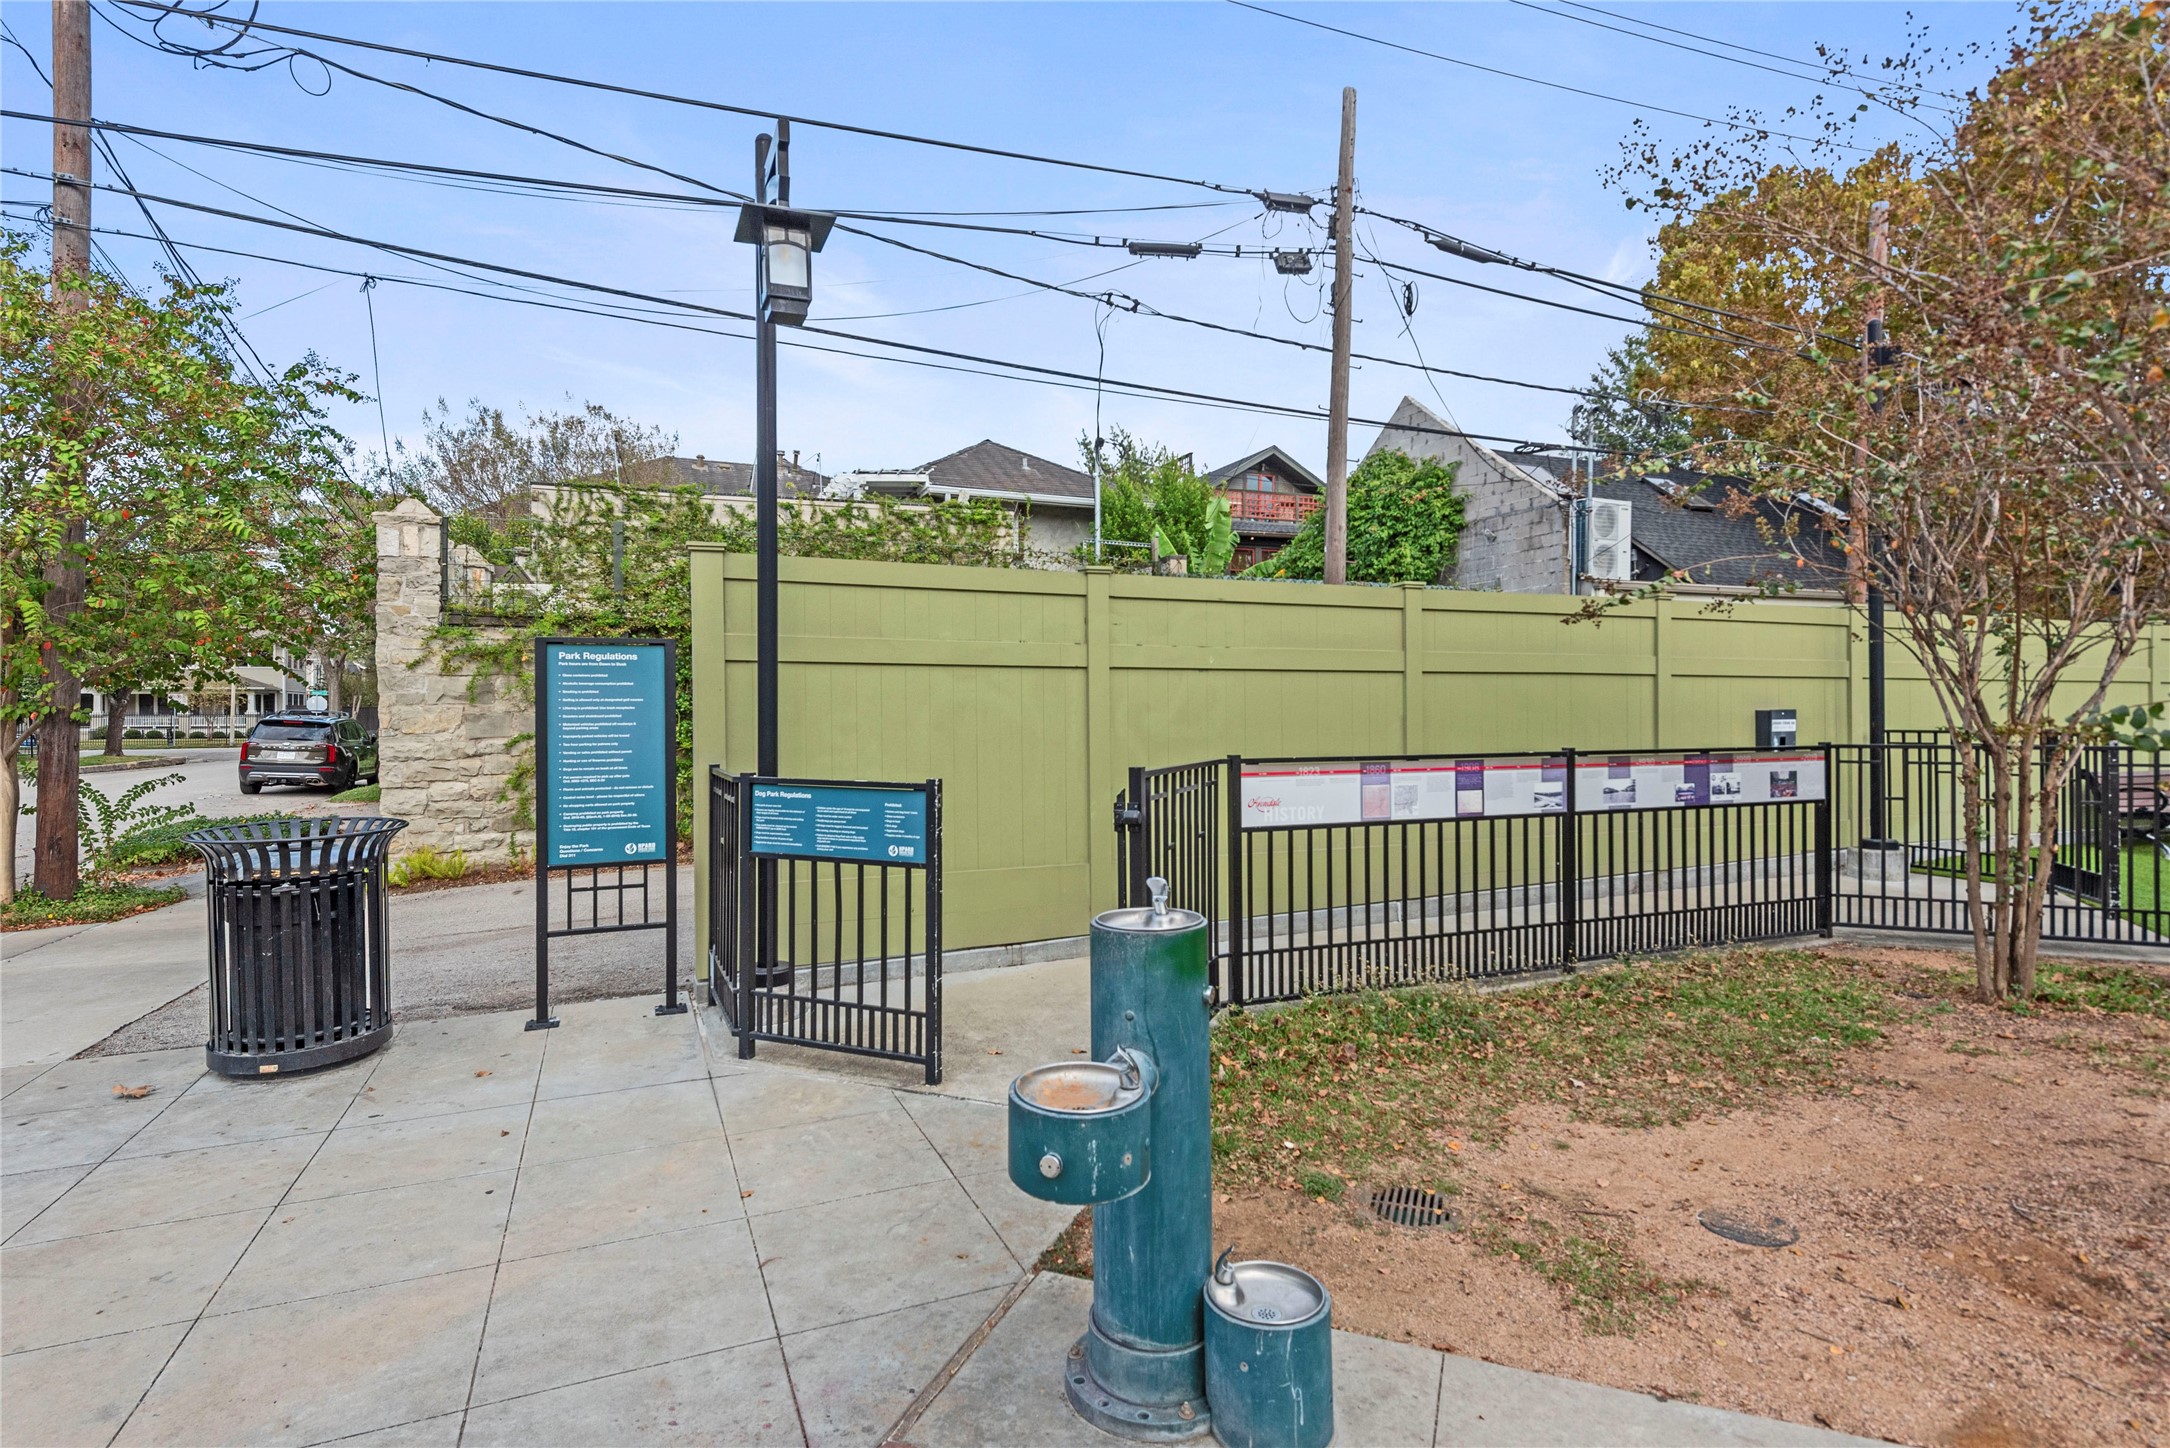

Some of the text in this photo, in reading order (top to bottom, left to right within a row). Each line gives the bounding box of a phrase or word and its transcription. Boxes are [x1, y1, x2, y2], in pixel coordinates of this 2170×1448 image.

[558, 652, 638, 662] Park Regulations
[754, 790, 766, 798] Dog
[780, 791, 812, 799] Regulations
[1263, 806, 1326, 824] HISTORY
